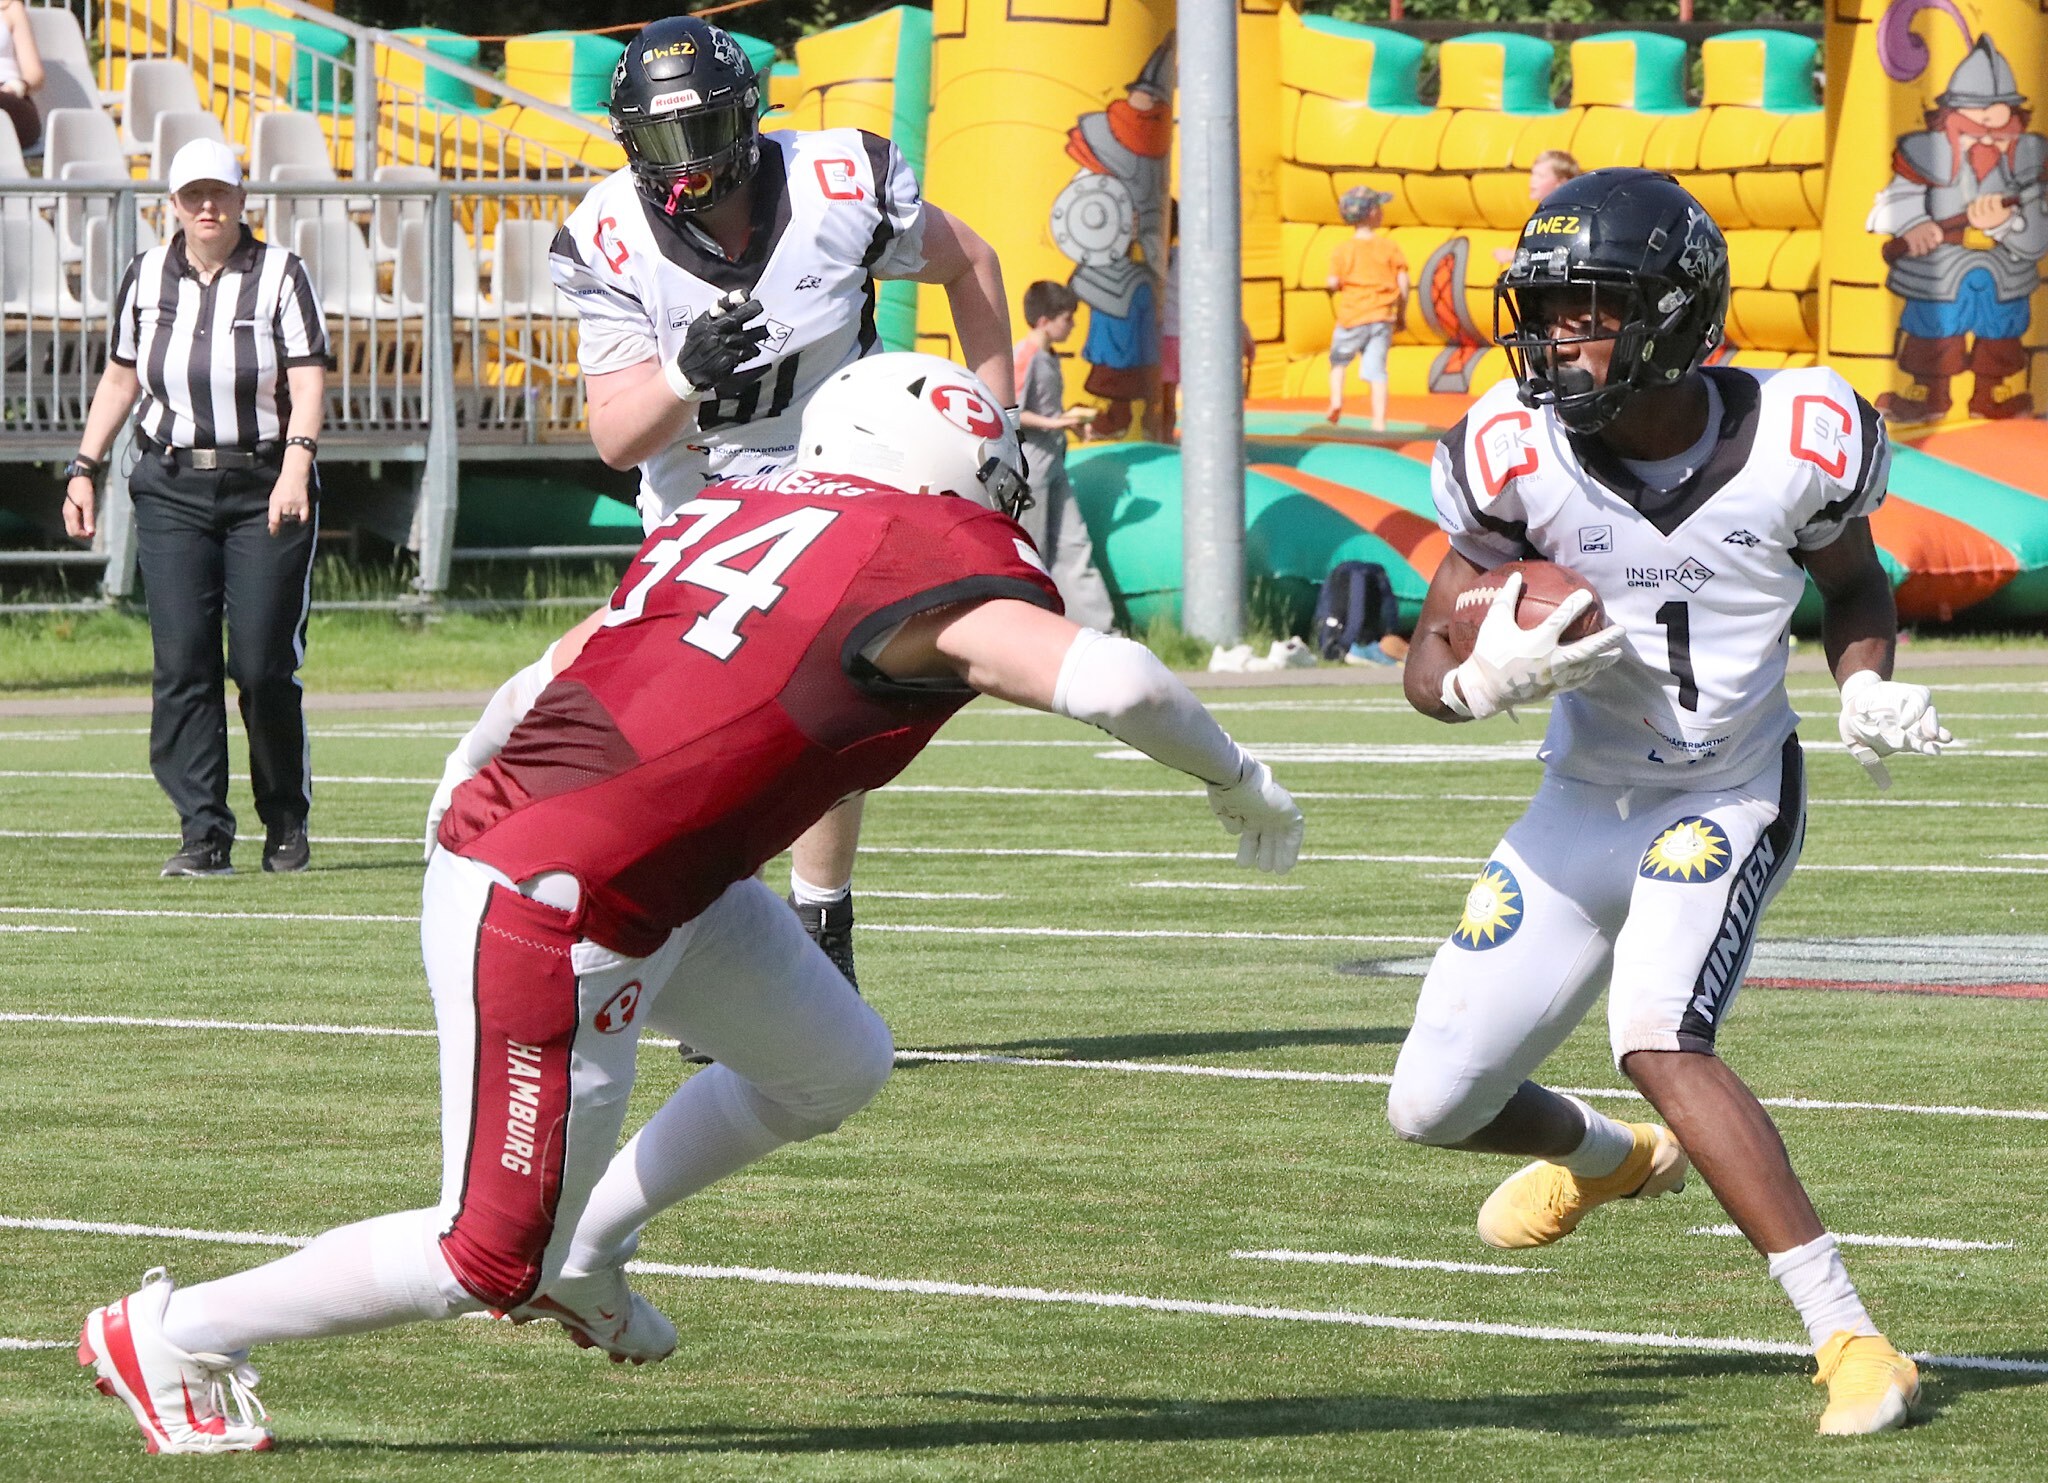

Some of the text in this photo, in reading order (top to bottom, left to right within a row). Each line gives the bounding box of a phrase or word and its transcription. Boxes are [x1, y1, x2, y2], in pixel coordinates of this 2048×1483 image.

[654, 43, 695, 59] WEZ
[655, 93, 693, 107] Riddell
[1536, 215, 1580, 234] WEZ
[600, 498, 843, 663] 34
[1626, 567, 1707, 581] INSIRAS
[1655, 601, 1699, 712] 1
[1693, 833, 1776, 1024] MINDEN
[501, 1039, 541, 1176] HAMBURG
